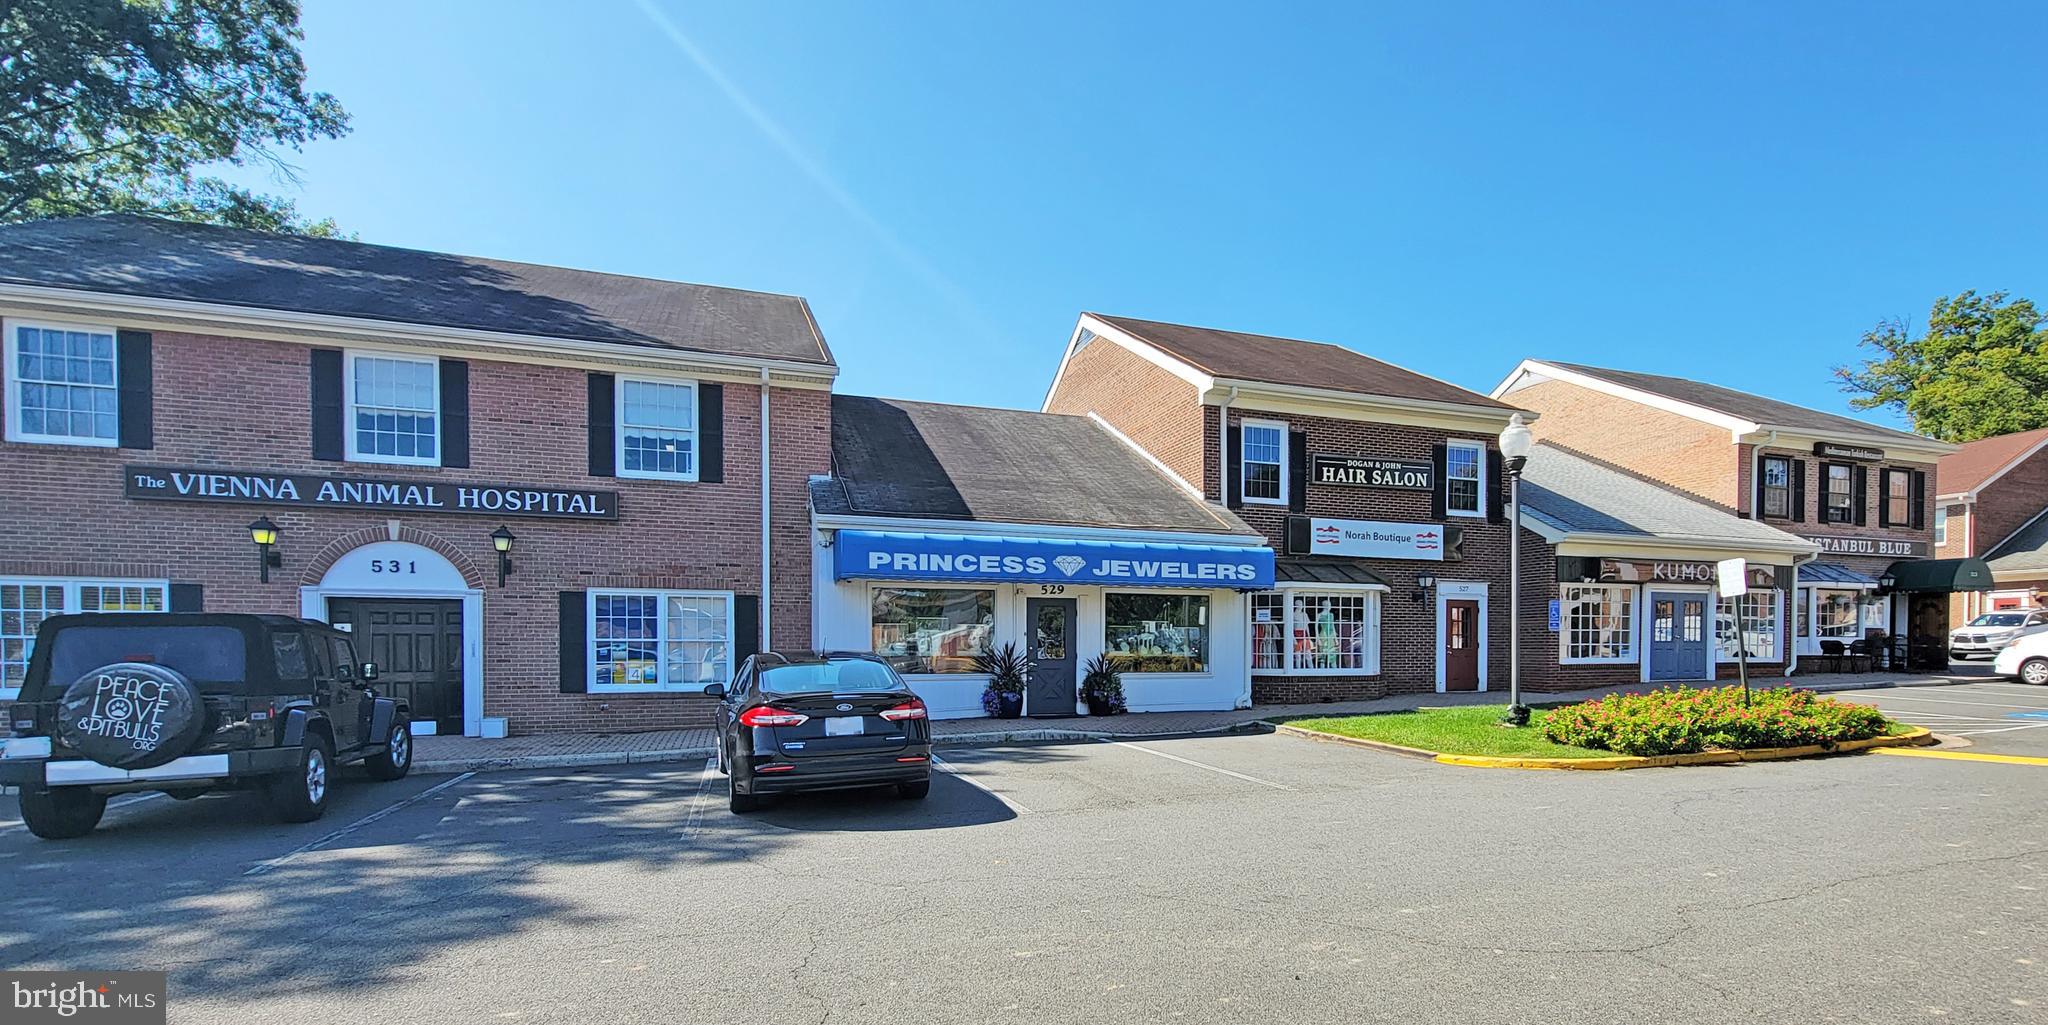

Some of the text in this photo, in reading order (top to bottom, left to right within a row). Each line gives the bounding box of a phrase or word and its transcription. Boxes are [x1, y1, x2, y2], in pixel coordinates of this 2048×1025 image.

[1347, 460, 1374, 468] DOGAN
[1381, 462, 1402, 470] JOHN
[1321, 466, 1428, 487] HAIR SALON
[134, 472, 606, 514] The VIENNA ANIMAL HOSPITAL
[1344, 530, 1371, 541] Norah
[1373, 532, 1412, 544] Boutique
[1878, 541, 1912, 555] BLUE
[371, 560, 416, 574] 531
[868, 551, 1256, 580] PRINCESS JEWELERS
[1041, 584, 1065, 595] 529
[96, 674, 174, 703] PEACE
[91, 694, 169, 726] LOVE
